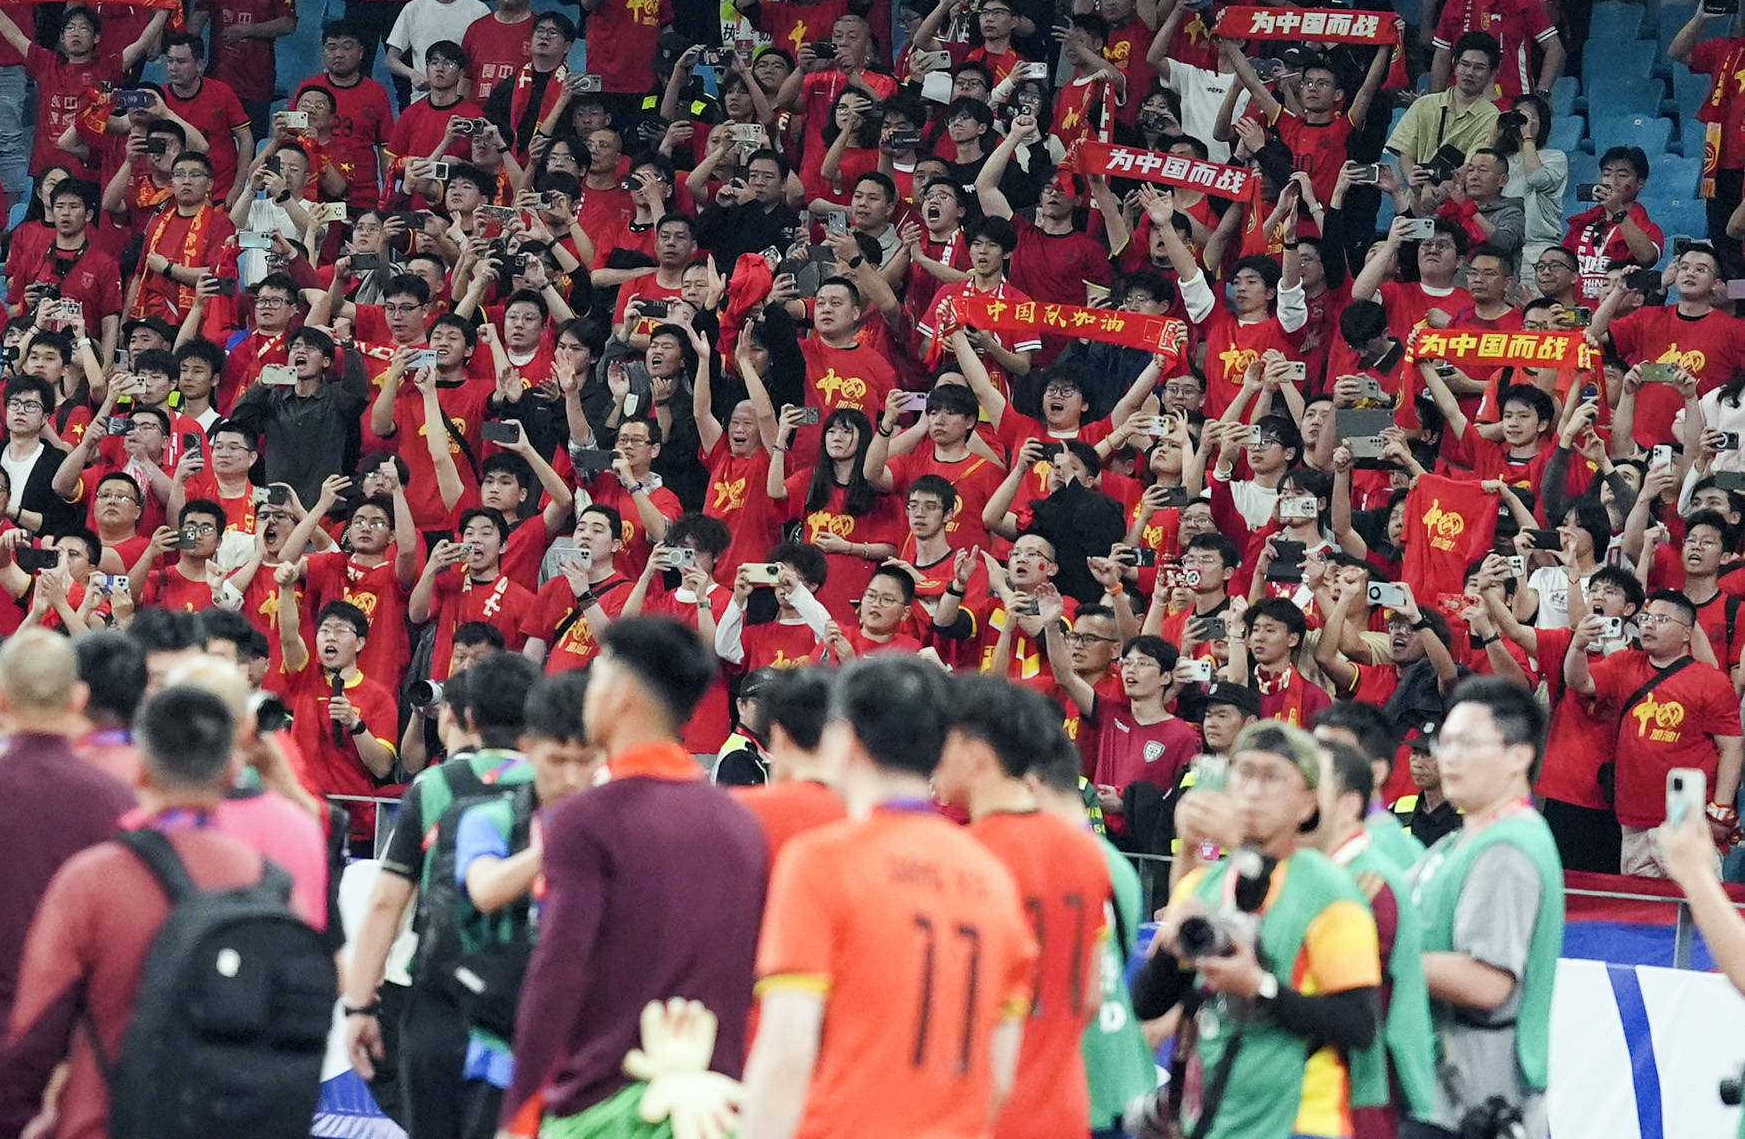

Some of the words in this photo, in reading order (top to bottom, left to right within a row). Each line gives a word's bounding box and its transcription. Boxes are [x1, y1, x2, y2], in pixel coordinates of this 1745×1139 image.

[1248, 10, 1381, 39] 为中国而战
[1105, 147, 1248, 195] 为中国而战
[985, 299, 1127, 333] 中国队加油
[1417, 332, 1571, 362] 为中国而战
